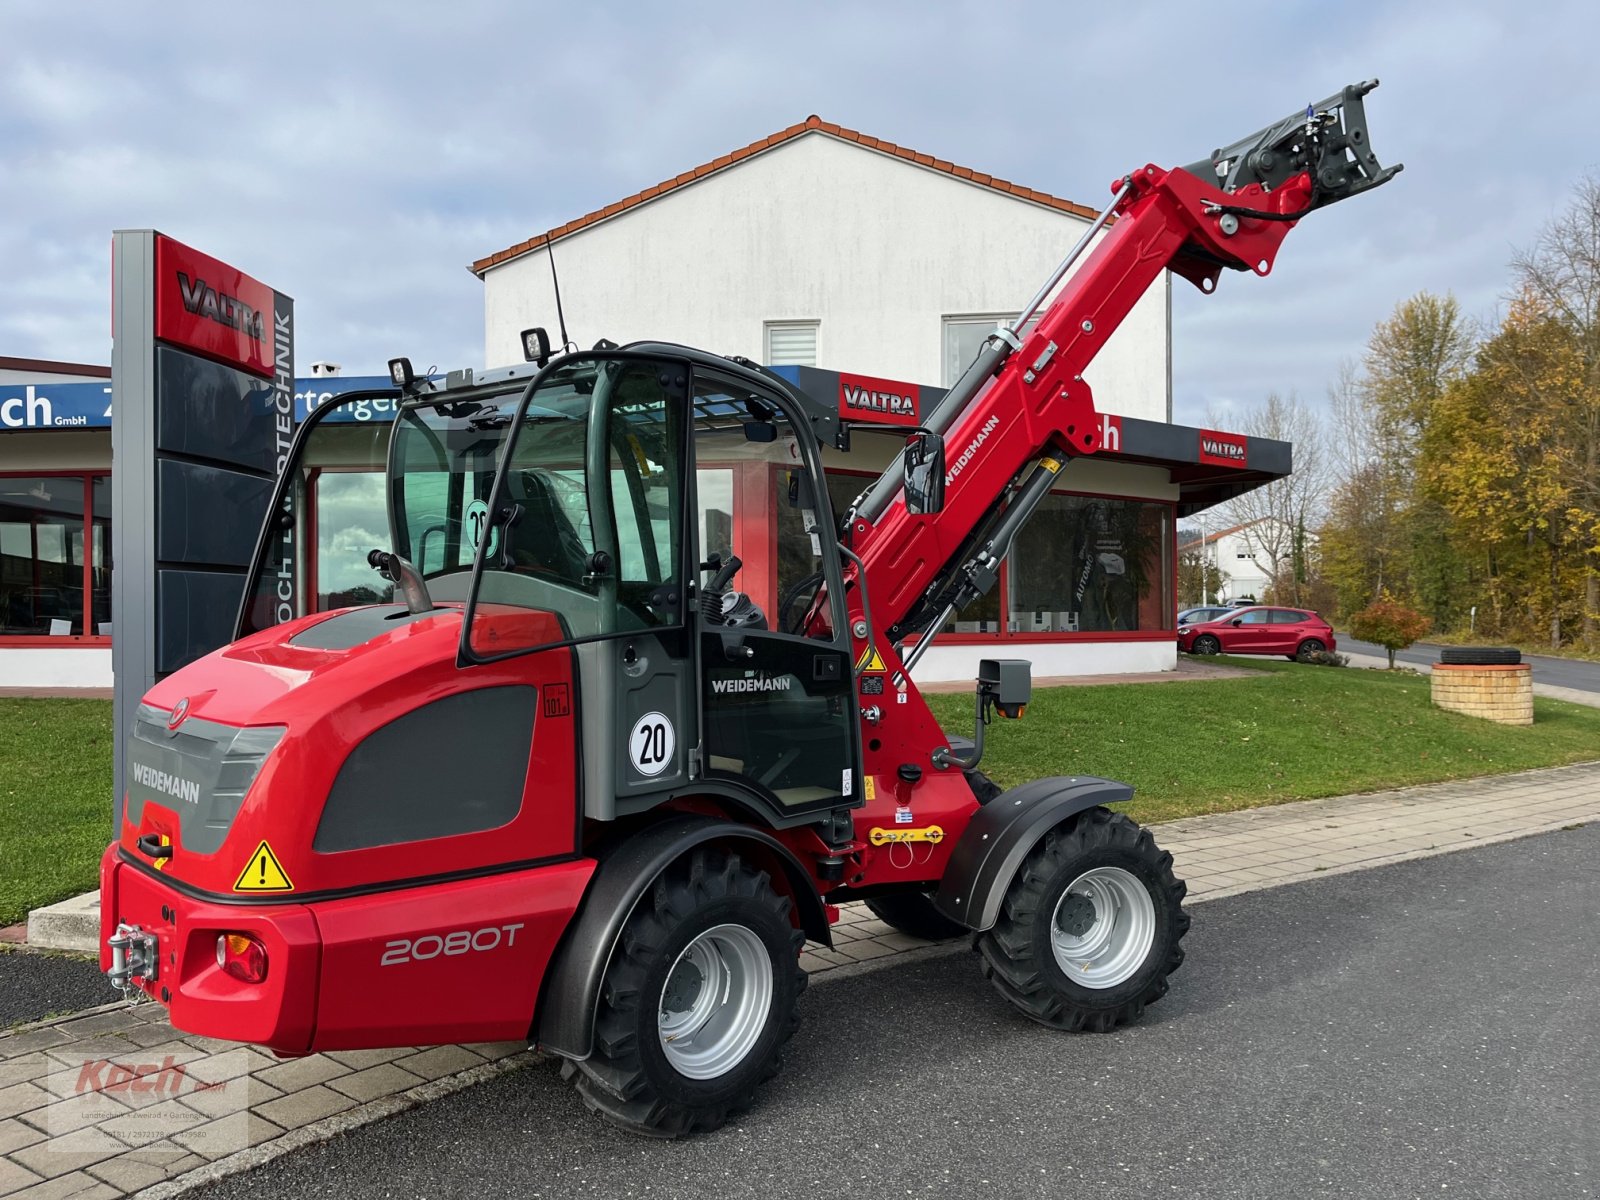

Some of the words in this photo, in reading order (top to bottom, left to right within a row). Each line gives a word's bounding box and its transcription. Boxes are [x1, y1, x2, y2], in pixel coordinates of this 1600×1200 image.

[176, 271, 266, 344] VALTRA
[54, 415, 87, 426] GmbH
[842, 383, 915, 416] VALTRA
[945, 414, 1000, 487] WEIDEMANN
[1202, 437, 1246, 461] VALTRA
[712, 678, 791, 693] WEIDEMANN
[640, 723, 666, 765] 20
[133, 762, 200, 804] WEIDEMANN
[380, 923, 525, 966] 2080T
